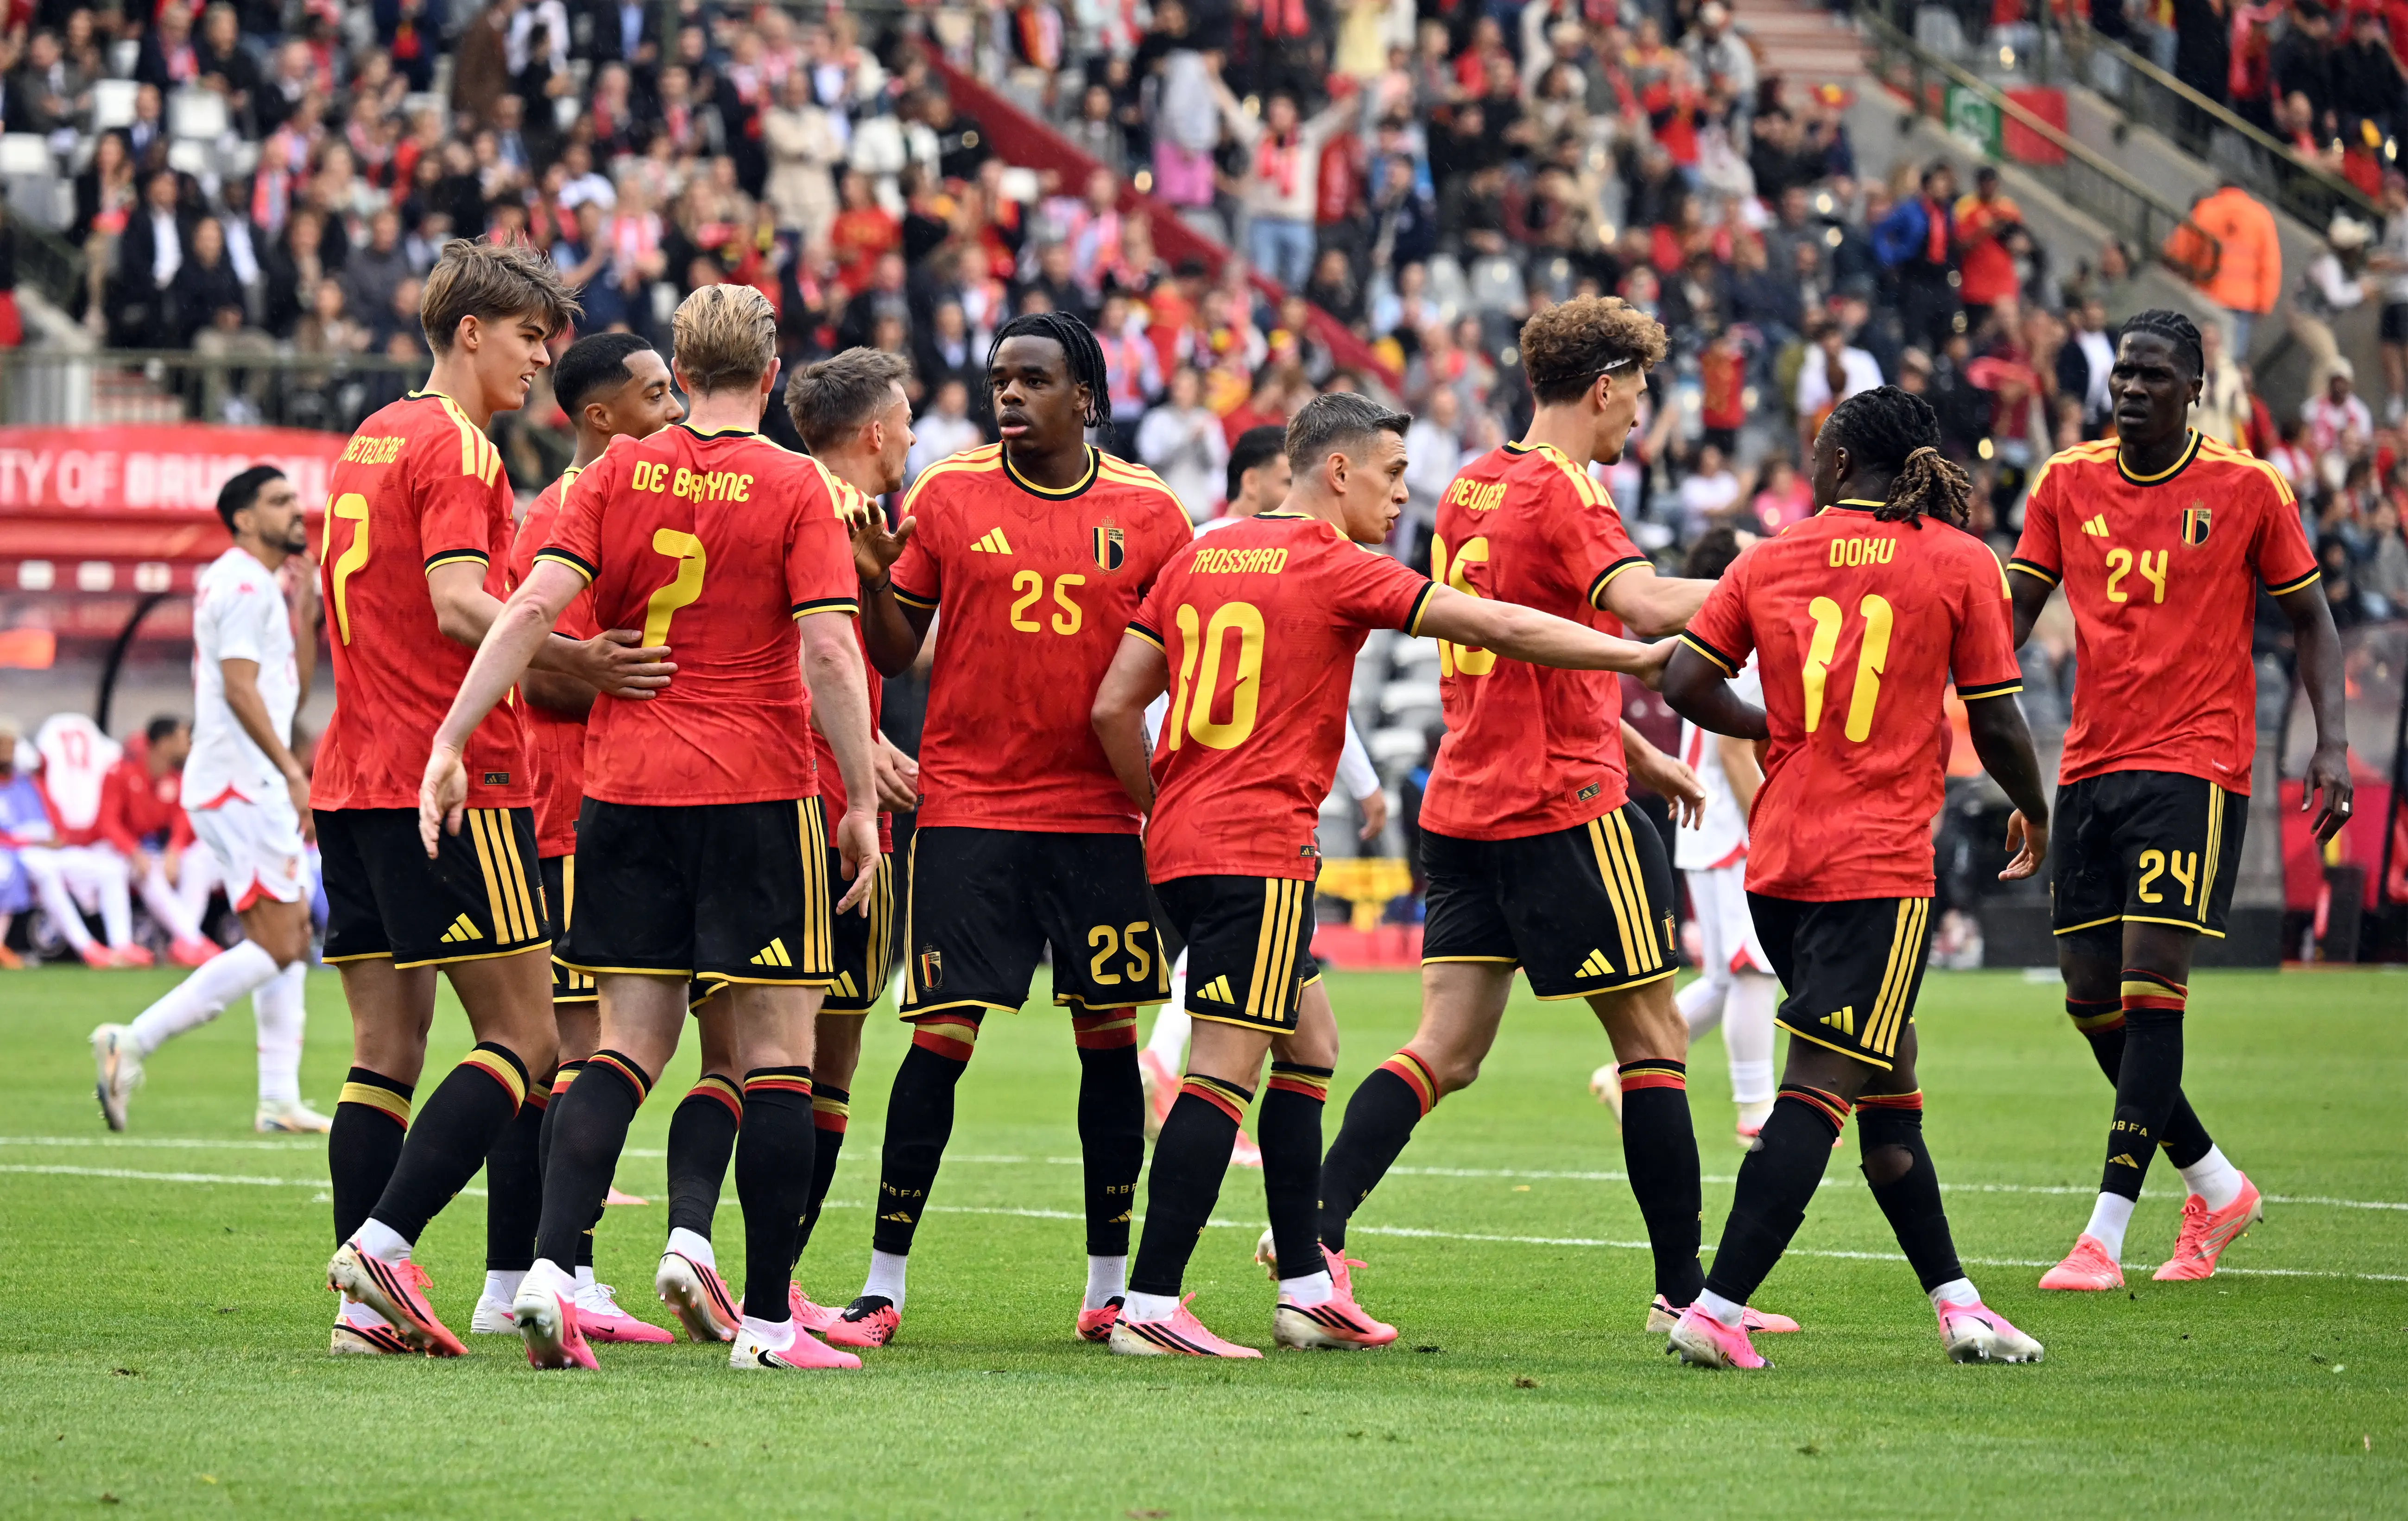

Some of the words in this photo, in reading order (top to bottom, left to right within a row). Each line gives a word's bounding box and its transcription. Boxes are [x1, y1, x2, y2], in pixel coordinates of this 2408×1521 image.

[57, 449, 118, 508] OF
[632, 461, 669, 493] DE
[1189, 547, 1289, 575] TROSSARD
[1829, 538, 1896, 567] DOKU
[2105, 548, 2169, 604] 24
[642, 528, 707, 663] 7
[1010, 570, 1086, 635] 25
[1169, 601, 1265, 751] 10
[1802, 594, 1893, 743] 11
[2138, 849, 2198, 906] 24
[1087, 921, 1150, 985] 25
[882, 1181, 922, 1198] RBFA
